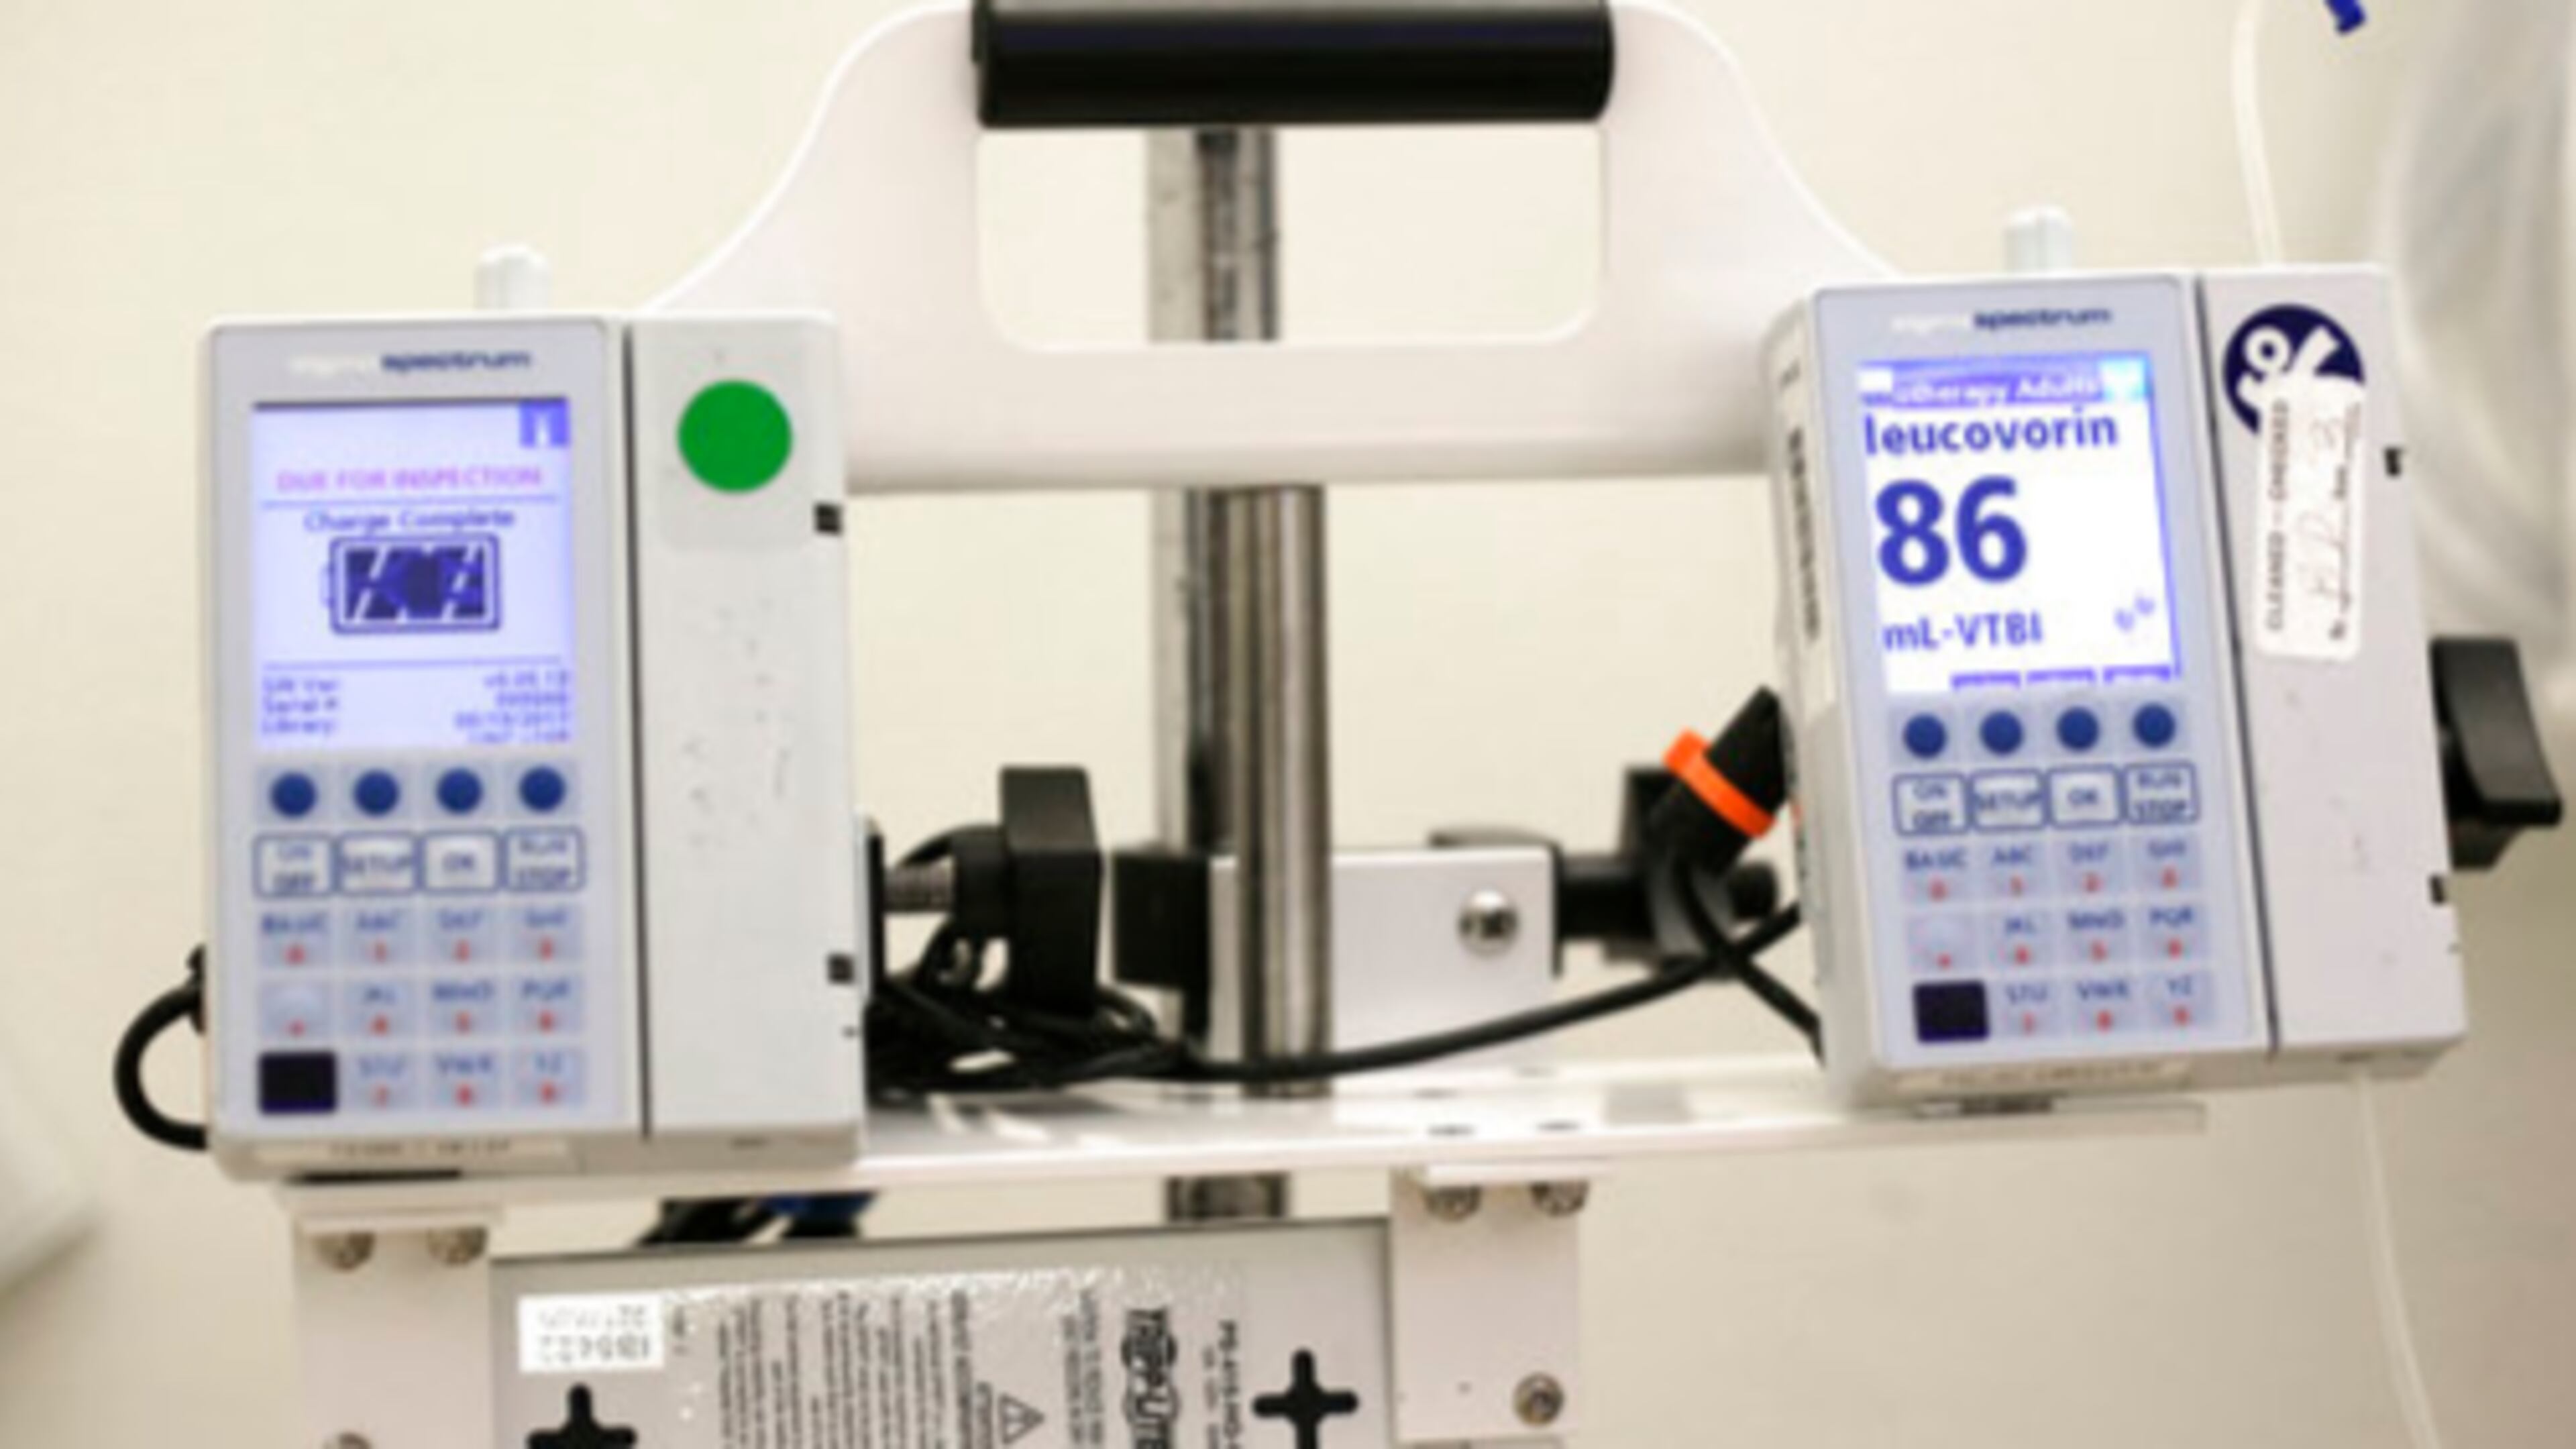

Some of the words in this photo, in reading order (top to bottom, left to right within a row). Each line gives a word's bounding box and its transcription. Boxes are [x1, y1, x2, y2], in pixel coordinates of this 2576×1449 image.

[1865, 402, 2118, 455] leucovorin
[276, 470, 326, 492] DUE
[337, 468, 387, 490] FOR
[394, 466, 543, 488] INSPECTION
[303, 510, 390, 535] Charge
[398, 508, 515, 533] Complete
[1876, 475, 2028, 587] 86
